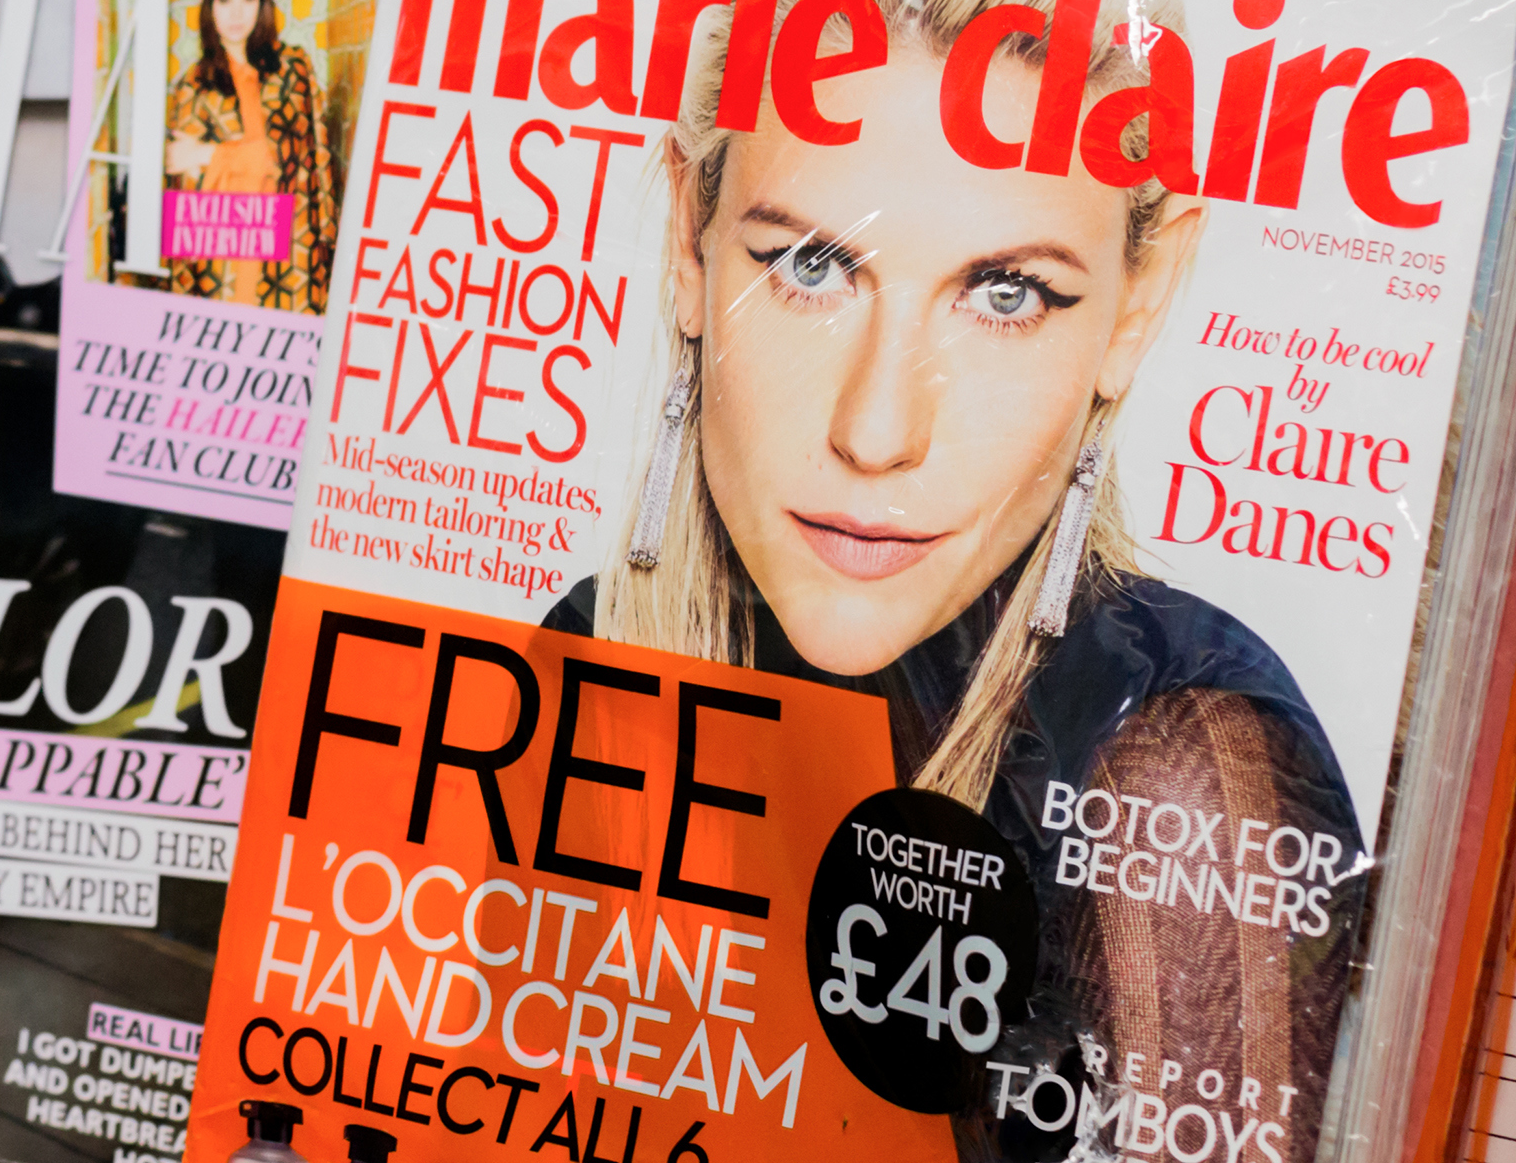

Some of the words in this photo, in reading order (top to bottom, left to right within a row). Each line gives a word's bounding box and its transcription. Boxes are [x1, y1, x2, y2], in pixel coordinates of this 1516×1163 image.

[174, 192, 281, 228] EXCLUSIVE
[363, 99, 646, 263] FAST
[1261, 226, 1395, 265] NOVEMBER
[1400, 250, 1447, 275] 2015
[350, 238, 629, 348] FASHION
[1385, 276, 1442, 304] £3.99
[158, 311, 255, 356] WHY
[1196, 311, 1281, 356] How
[1284, 328, 1318, 361] to
[1323, 327, 1357, 368] be
[1363, 341, 1436, 379] cool
[71, 340, 172, 386] TIME
[180, 357, 230, 394] TO
[224, 365, 314, 410] JOIN
[81, 384, 162, 428] THE
[329, 310, 593, 464] FIXES
[1286, 364, 1331, 414] by
[108, 431, 189, 475] FAN
[1188, 384, 1411, 495] Claire
[322, 432, 477, 492] Mid-season
[482, 464, 603, 521] updates,
[316, 482, 418, 524] modern
[423, 496, 547, 557] tailoring
[547, 516, 577, 554] &
[1150, 460, 1395, 579] Danes
[310, 513, 350, 553] the
[352, 533, 409, 564] new
[409, 533, 475, 579] skirt
[478, 547, 564, 600] shape
[287, 610, 782, 920] FREE
[1, 812, 142, 862] BEHIND
[154, 828, 230, 874] HER
[850, 822, 1006, 891] TOGETHER
[1041, 779, 1225, 863] BOTOX
[1235, 816, 1345, 886] FOR
[18, 875, 156, 921] EMPIRE
[870, 867, 973, 926] WORTH
[1055, 835, 1332, 939] BEGINNERS
[271, 832, 766, 1024] L'OCCITANE
[819, 902, 1009, 1054] £48
[17, 1026, 31, 1055] I
[33, 1030, 98, 1068] GOT
[99, 1044, 200, 1091] DUMPE
[90, 1010, 161, 1048] REAL
[253, 920, 493, 1048] HAND
[501, 980, 808, 1129] CREAM
[2, 1058, 70, 1097] AND
[72, 1074, 192, 1123] OPENED
[238, 1015, 540, 1145] COLLECT
[527, 1089, 643, 1163] ALL
[985, 1060, 1287, 1163] TOMBOYS
[1084, 1043, 1299, 1118] REPORT
[26, 1094, 189, 1156] HEARTBREA
